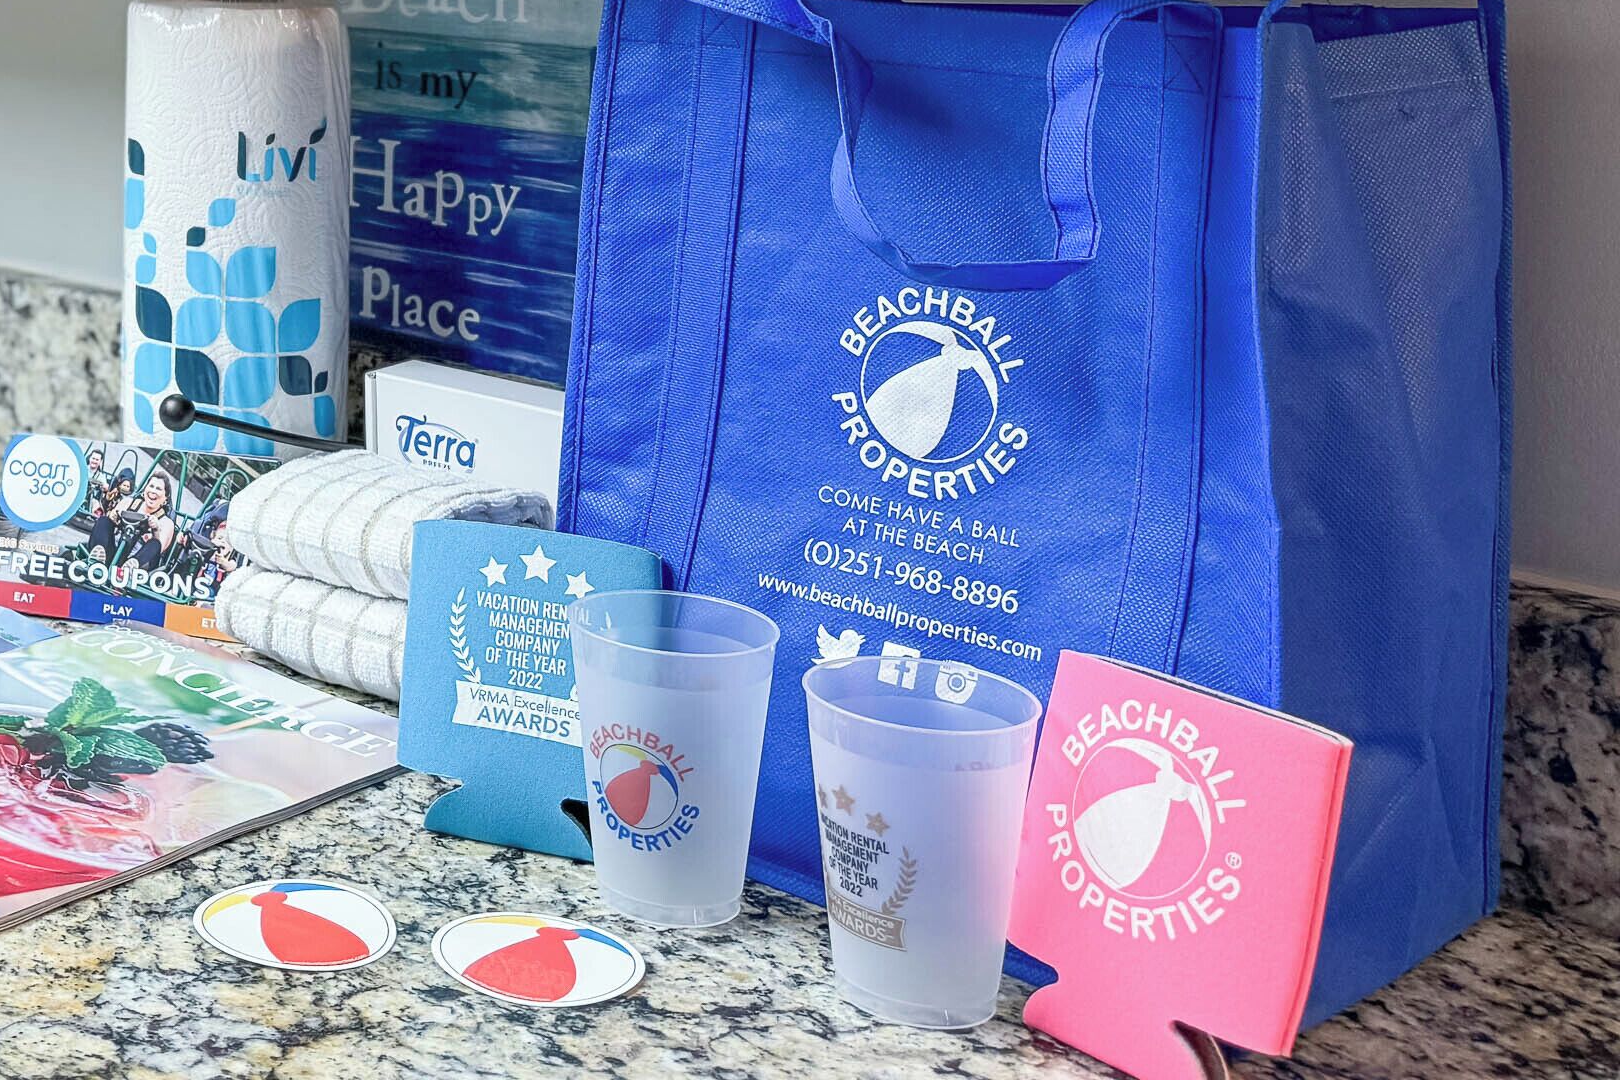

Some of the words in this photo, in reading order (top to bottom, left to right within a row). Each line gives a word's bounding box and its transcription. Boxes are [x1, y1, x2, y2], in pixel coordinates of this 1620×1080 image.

[375, 42, 402, 91] is
[420, 60, 477, 110] my
[237, 117, 327, 182] Livi
[349, 136, 521, 236] Happy
[361, 265, 481, 341] Place
[838, 286, 1025, 384] BEACHBALL
[396, 414, 476, 469] Terra
[832, 390, 1030, 501] PROPERTIES
[817, 485, 882, 516] COME
[887, 500, 945, 530] HAVE
[947, 516, 964, 534] A
[971, 522, 1021, 549] BALL
[841, 517, 868, 537] AT
[873, 522, 907, 548] THE
[912, 533, 985, 566] BEACH
[13, 591, 35, 604] EAT
[67, 560, 211, 600] COUPONS
[103, 603, 133, 617] PLAY
[476, 590, 539, 617] VACATION
[757, 572, 1043, 662] www.beachballproperties.com
[201, 617, 218, 630] ET
[489, 611, 571, 640] MANAGEMEN
[495, 629, 561, 657] COMPANY
[485, 646, 502, 664] OF
[506, 650, 530, 670] THE
[533, 655, 567, 677] YEAR
[508, 669, 544, 690] 2022
[70, 630, 395, 758] CONCIERGE
[470, 687, 510, 707] VRMA
[514, 695, 581, 720] Excellence
[477, 706, 571, 738] AWARDS
[590, 723, 694, 782] BEACHBALL
[1061, 698, 1247, 824] BEACHBALL
[592, 780, 700, 852] PROPERTIES
[831, 846, 869, 874] COMPANY
[851, 831, 890, 855] RENTAL
[829, 855, 836, 870] OF
[837, 861, 852, 880] THE
[853, 871, 879, 891] YEAR
[840, 876, 863, 898] 2022
[830, 903, 887, 942] AWARDS
